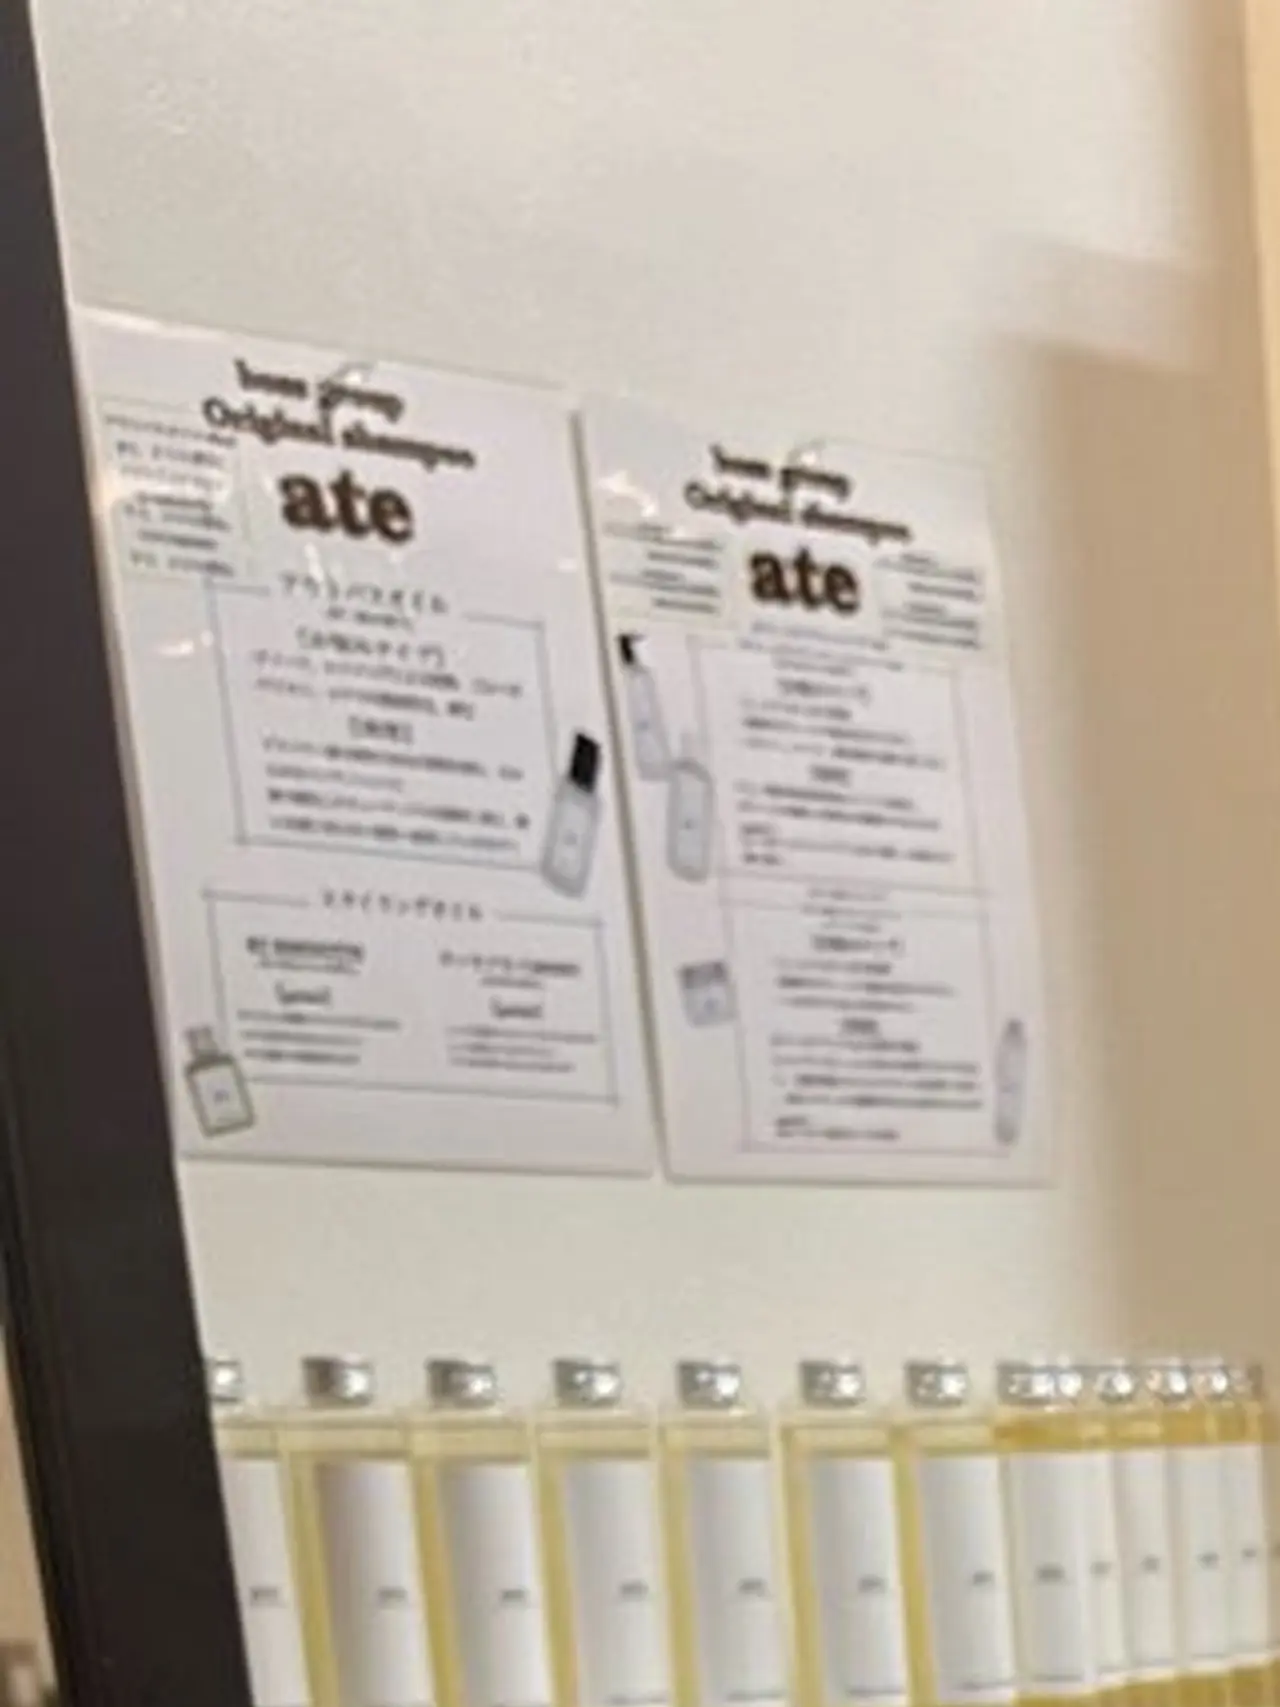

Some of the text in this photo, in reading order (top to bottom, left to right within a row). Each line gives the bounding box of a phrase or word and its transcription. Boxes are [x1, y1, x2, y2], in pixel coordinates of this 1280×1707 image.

[202, 395, 477, 472] Original shampoo
[279, 468, 415, 546] ate
[750, 545, 859, 617] ate
